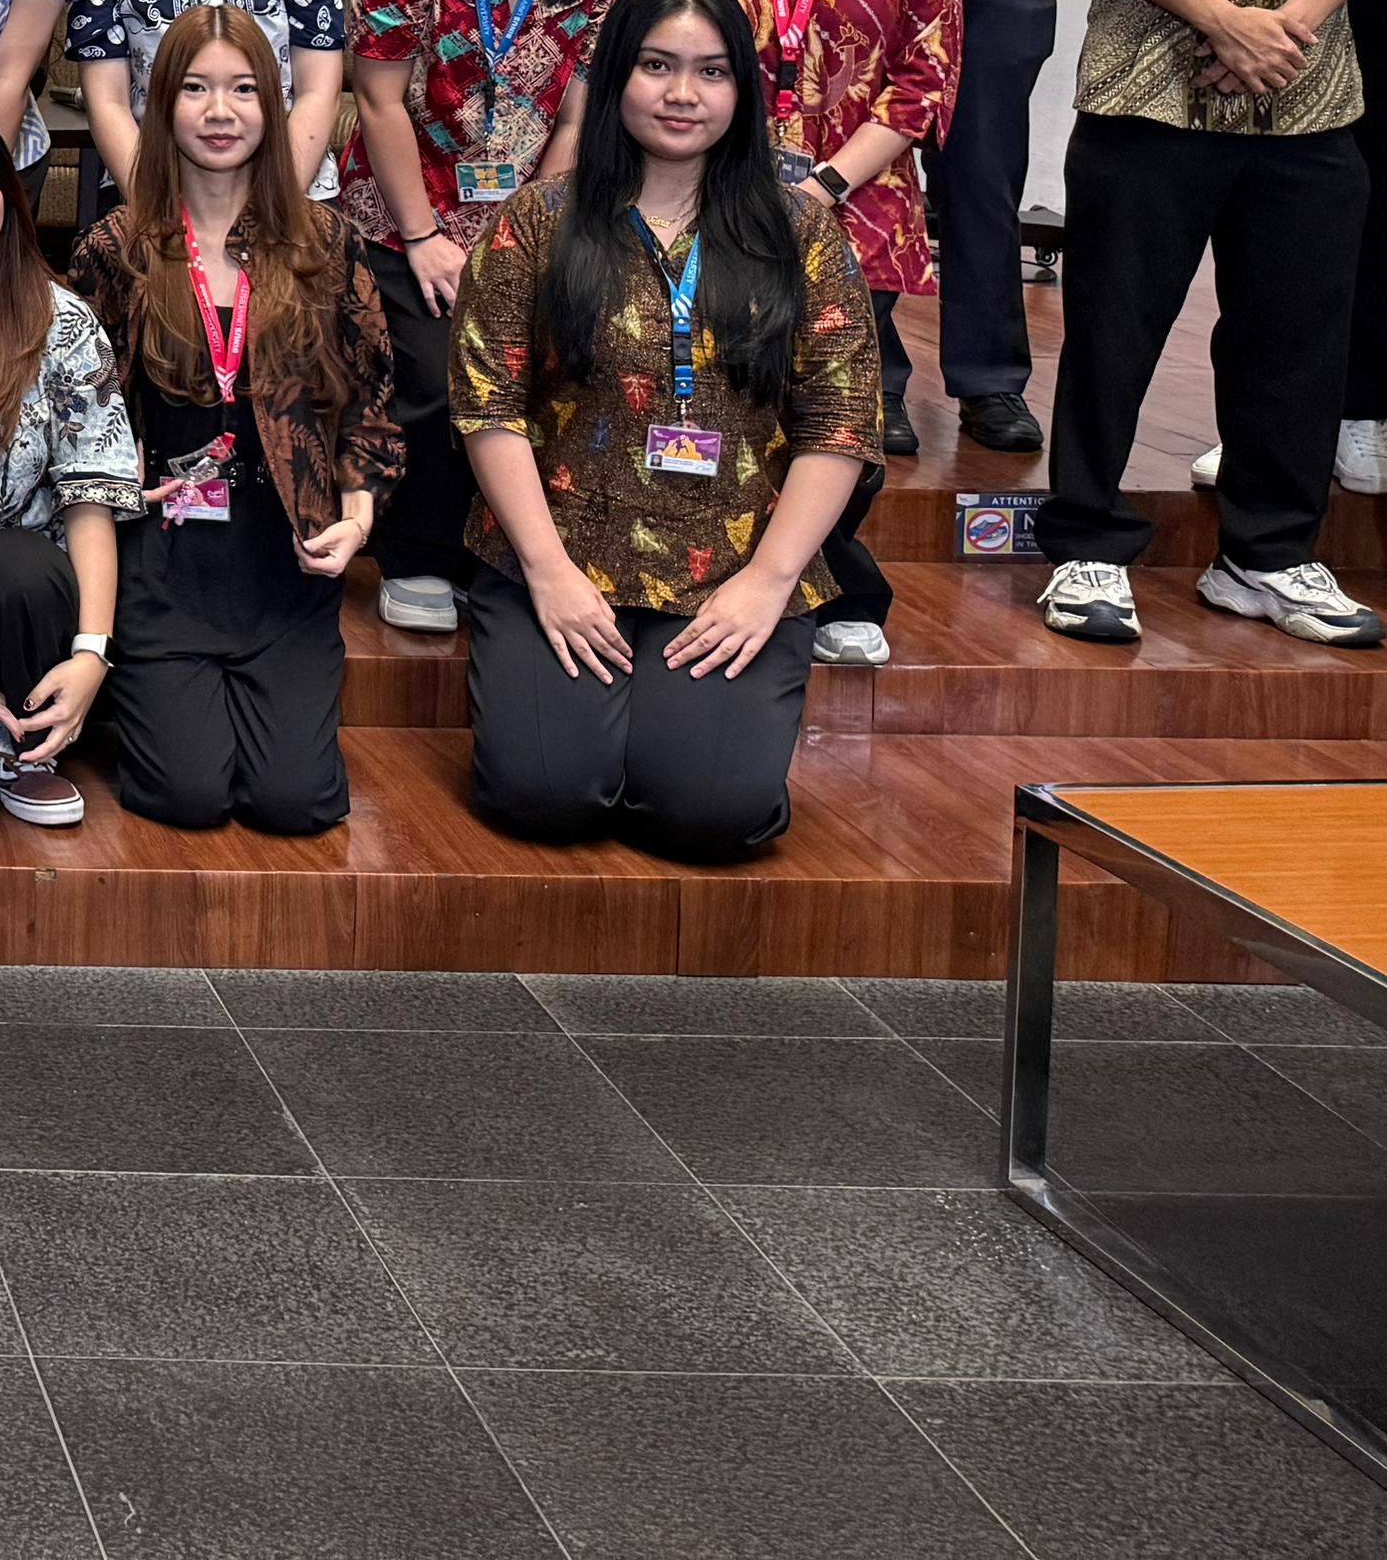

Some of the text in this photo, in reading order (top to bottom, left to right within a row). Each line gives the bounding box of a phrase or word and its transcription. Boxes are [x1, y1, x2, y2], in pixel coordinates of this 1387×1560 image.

[504, 15, 521, 39] BINUS
[231, 327, 242, 353] BINUS
[992, 497, 1045, 506] ATTENTIO
